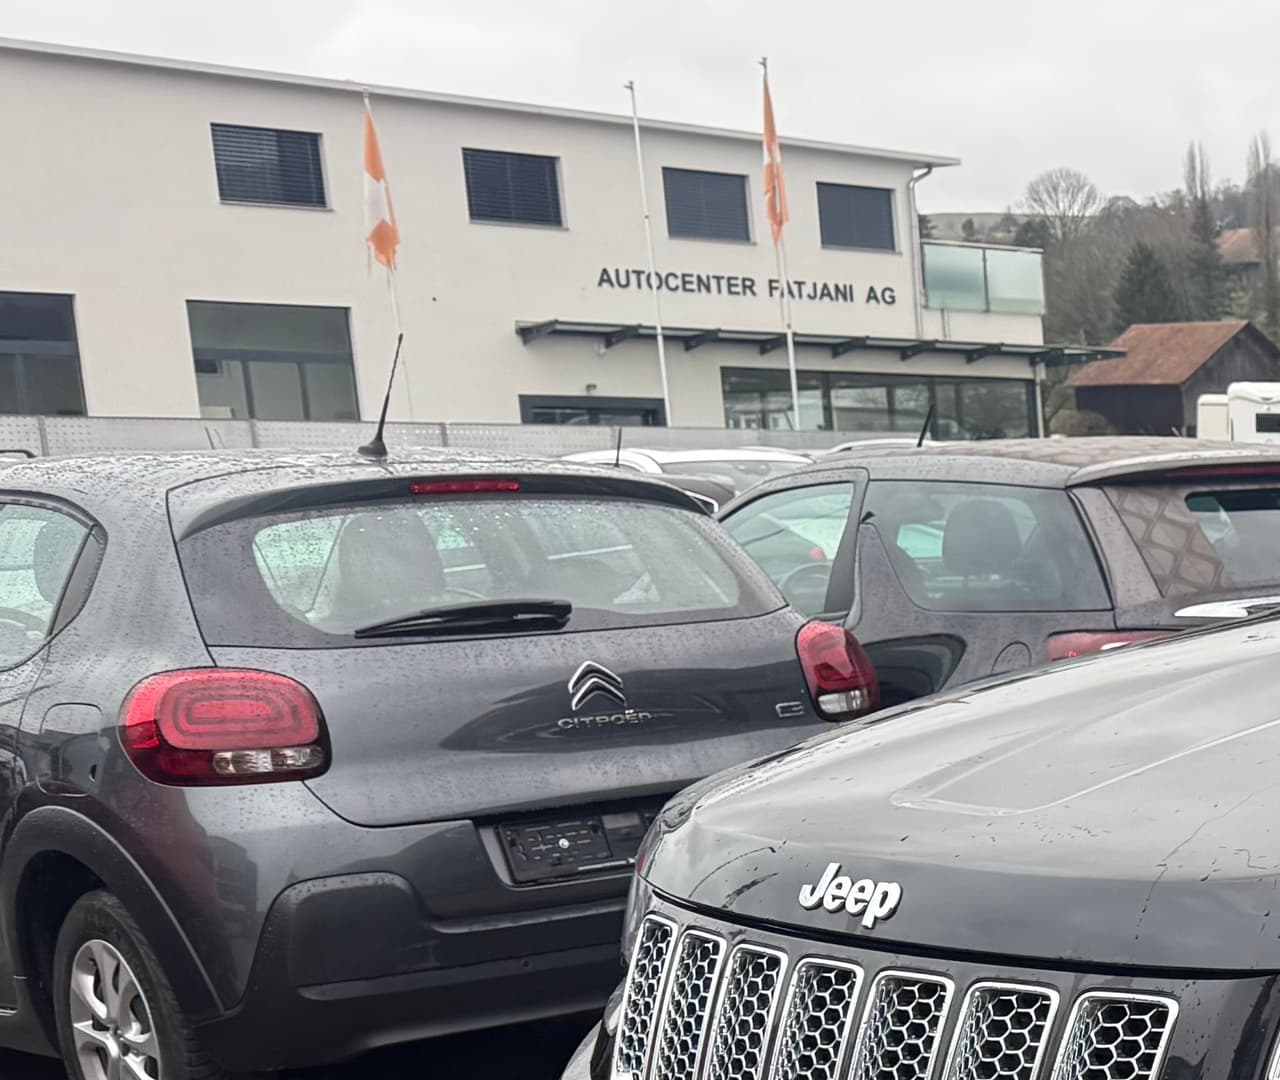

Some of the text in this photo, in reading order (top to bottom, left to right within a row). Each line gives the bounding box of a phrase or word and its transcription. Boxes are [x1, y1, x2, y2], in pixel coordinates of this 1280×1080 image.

[597, 267, 896, 305] AUTOCENTER FATJANI AG
[798, 862, 903, 929] Jeep
